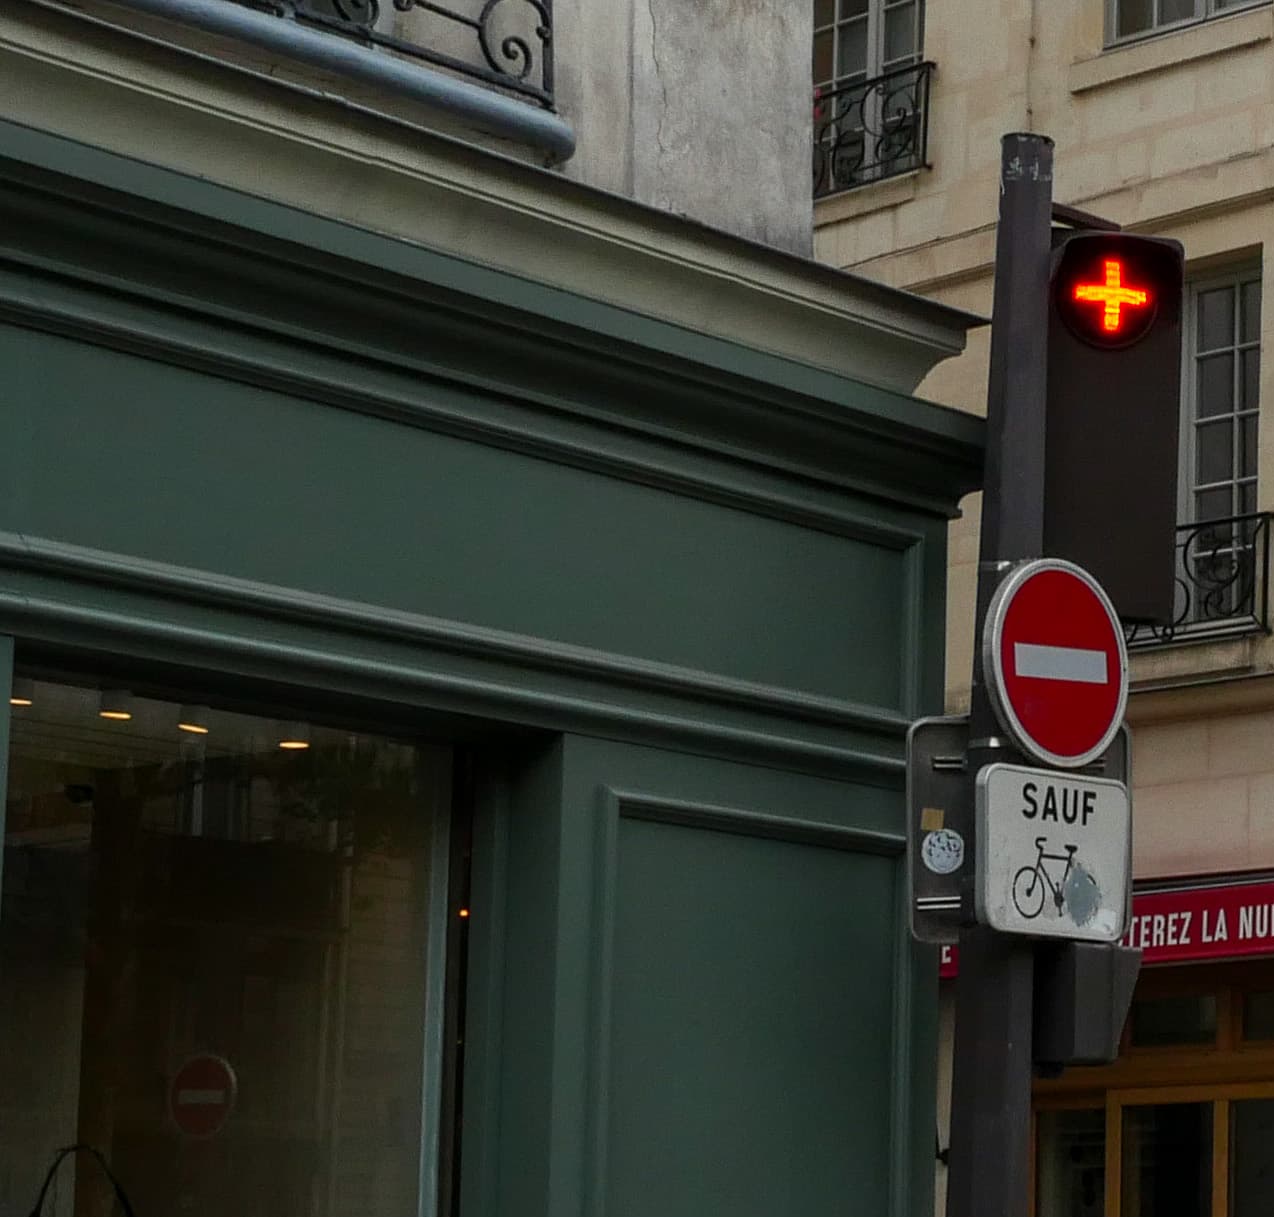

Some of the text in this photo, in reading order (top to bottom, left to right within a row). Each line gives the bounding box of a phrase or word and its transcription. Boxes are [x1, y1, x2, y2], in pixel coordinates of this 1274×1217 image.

[1021, 782, 1098, 827] SAUF
[1118, 911, 1193, 950] TEREZ
[1201, 908, 1228, 943] LA
